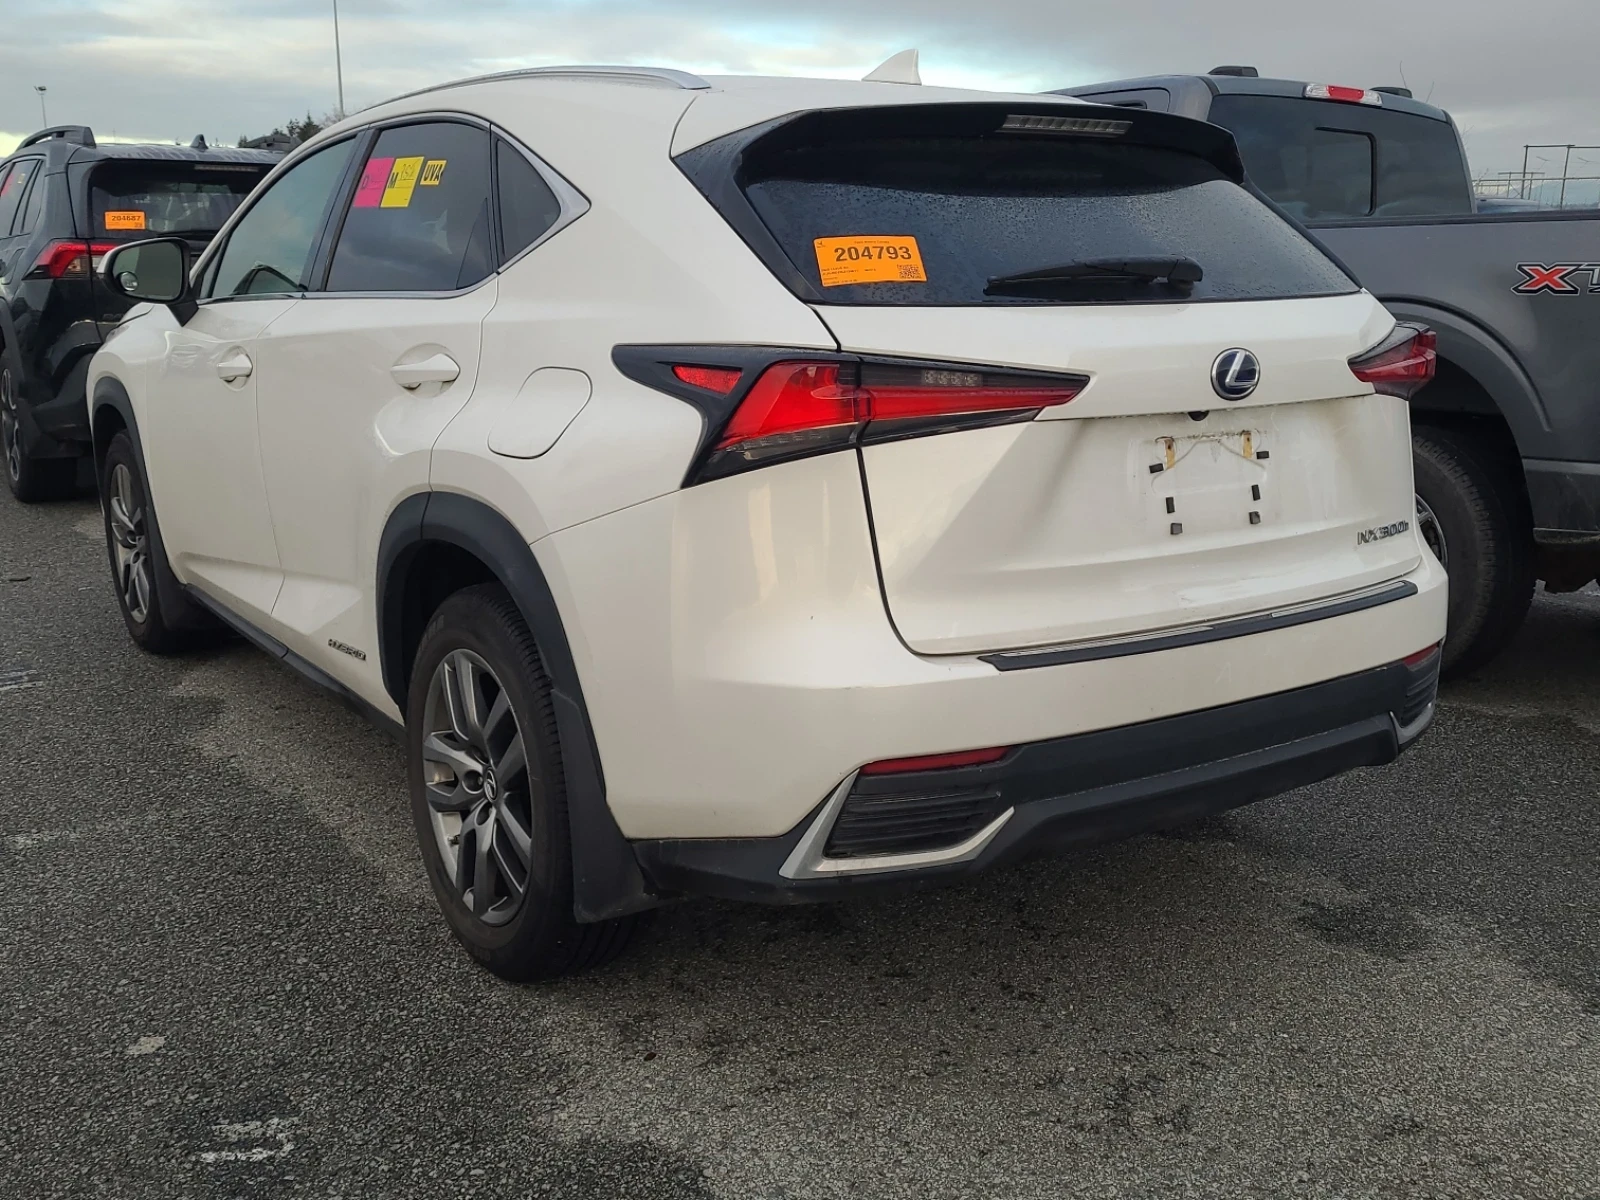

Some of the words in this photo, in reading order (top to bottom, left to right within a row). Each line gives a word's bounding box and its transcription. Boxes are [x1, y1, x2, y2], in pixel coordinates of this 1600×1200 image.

[423, 163, 443, 182] UVA
[834, 246, 912, 262] 204793
[328, 639, 366, 661] HYBRID
